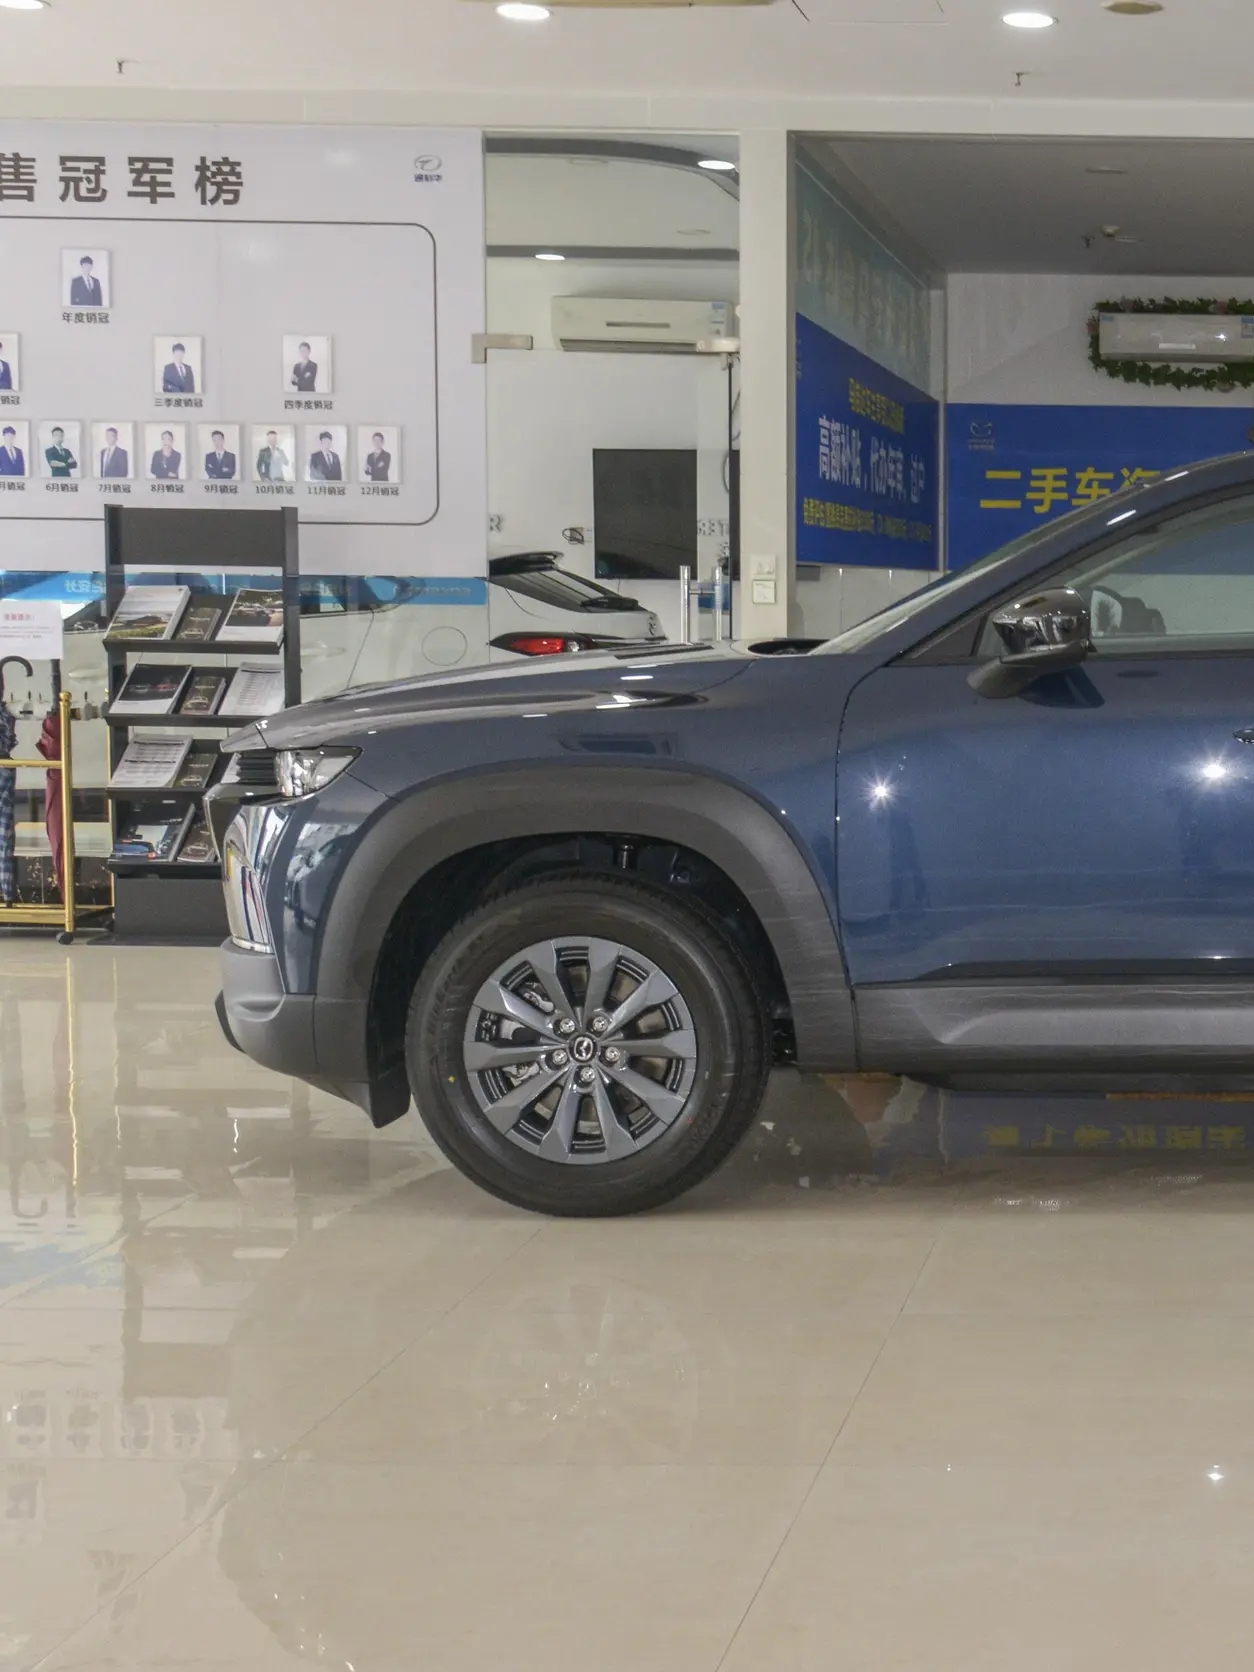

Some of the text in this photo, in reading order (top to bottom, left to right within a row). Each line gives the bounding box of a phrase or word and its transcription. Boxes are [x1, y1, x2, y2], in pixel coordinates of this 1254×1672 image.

[0, 152, 244, 206] 售冠军榜
[62, 312, 110, 324] 年度销冠
[154, 398, 204, 408] 三季度销冠
[284, 400, 333, 410] 四季度销冠
[45, 483, 79, 493] 6月销冠
[98, 484, 132, 494] 7月销冠
[150, 484, 185, 494] 8月销冠
[204, 484, 238, 494] 9月销冠
[255, 485, 295, 495] 10月销冠
[307, 486, 346, 496] 11月销冠
[360, 486, 400, 497] 12月销冠
